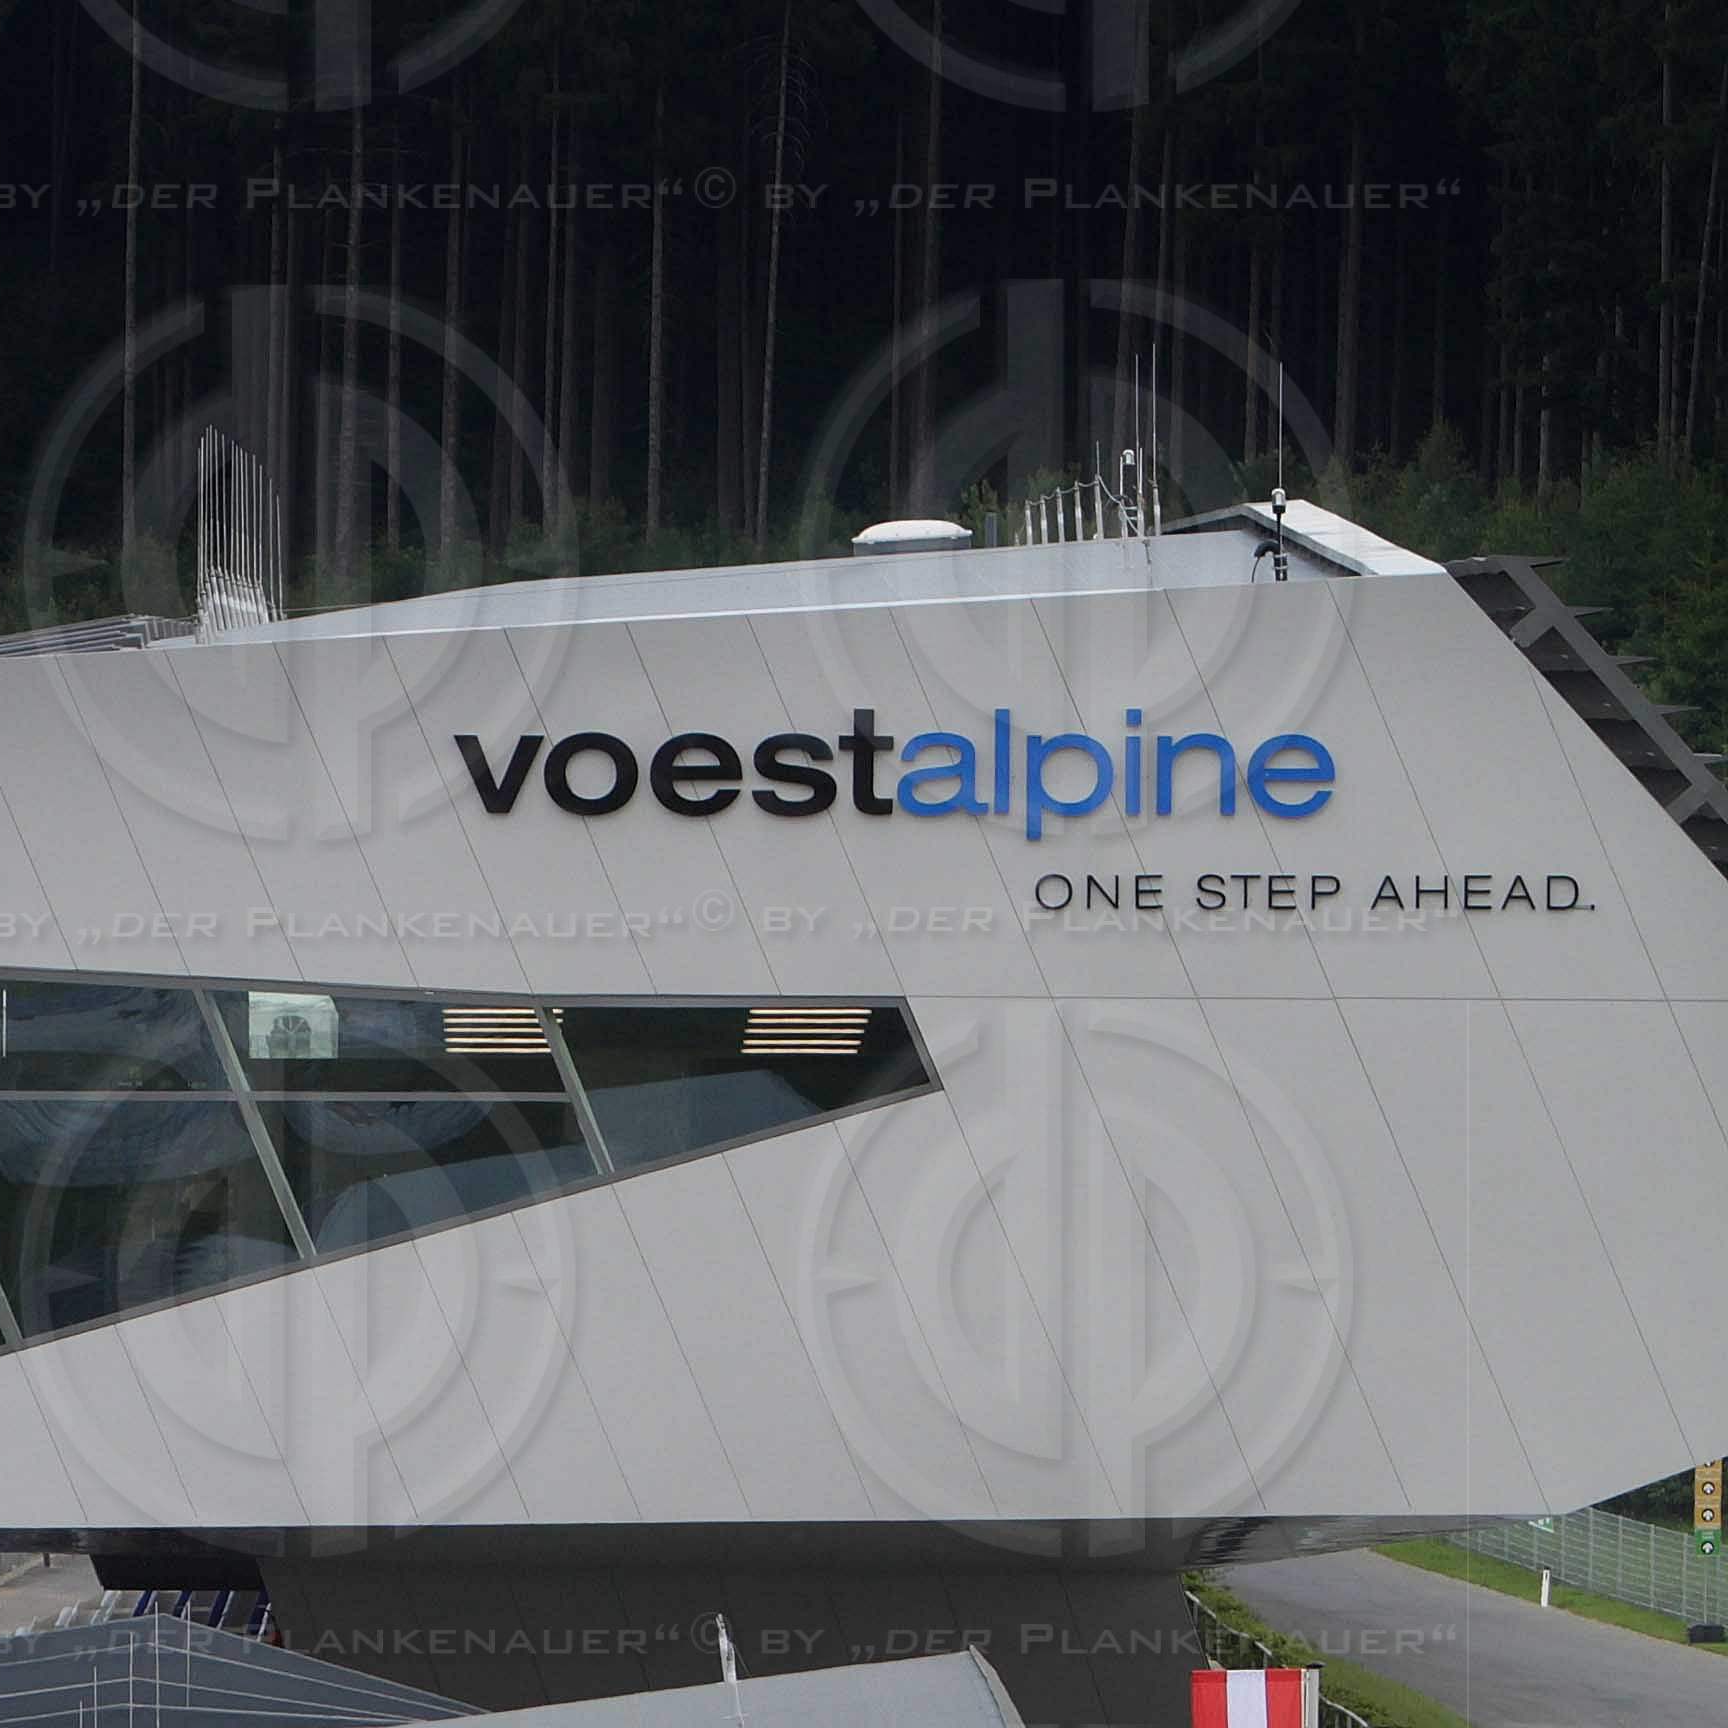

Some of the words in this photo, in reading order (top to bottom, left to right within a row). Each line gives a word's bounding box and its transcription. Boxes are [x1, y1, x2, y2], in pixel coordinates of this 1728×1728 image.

[454, 708, 1336, 841] voestalpine
[1034, 874, 1164, 912] ONE
[1196, 874, 1341, 912] STEP
[1371, 874, 1595, 913] AHEAD.
